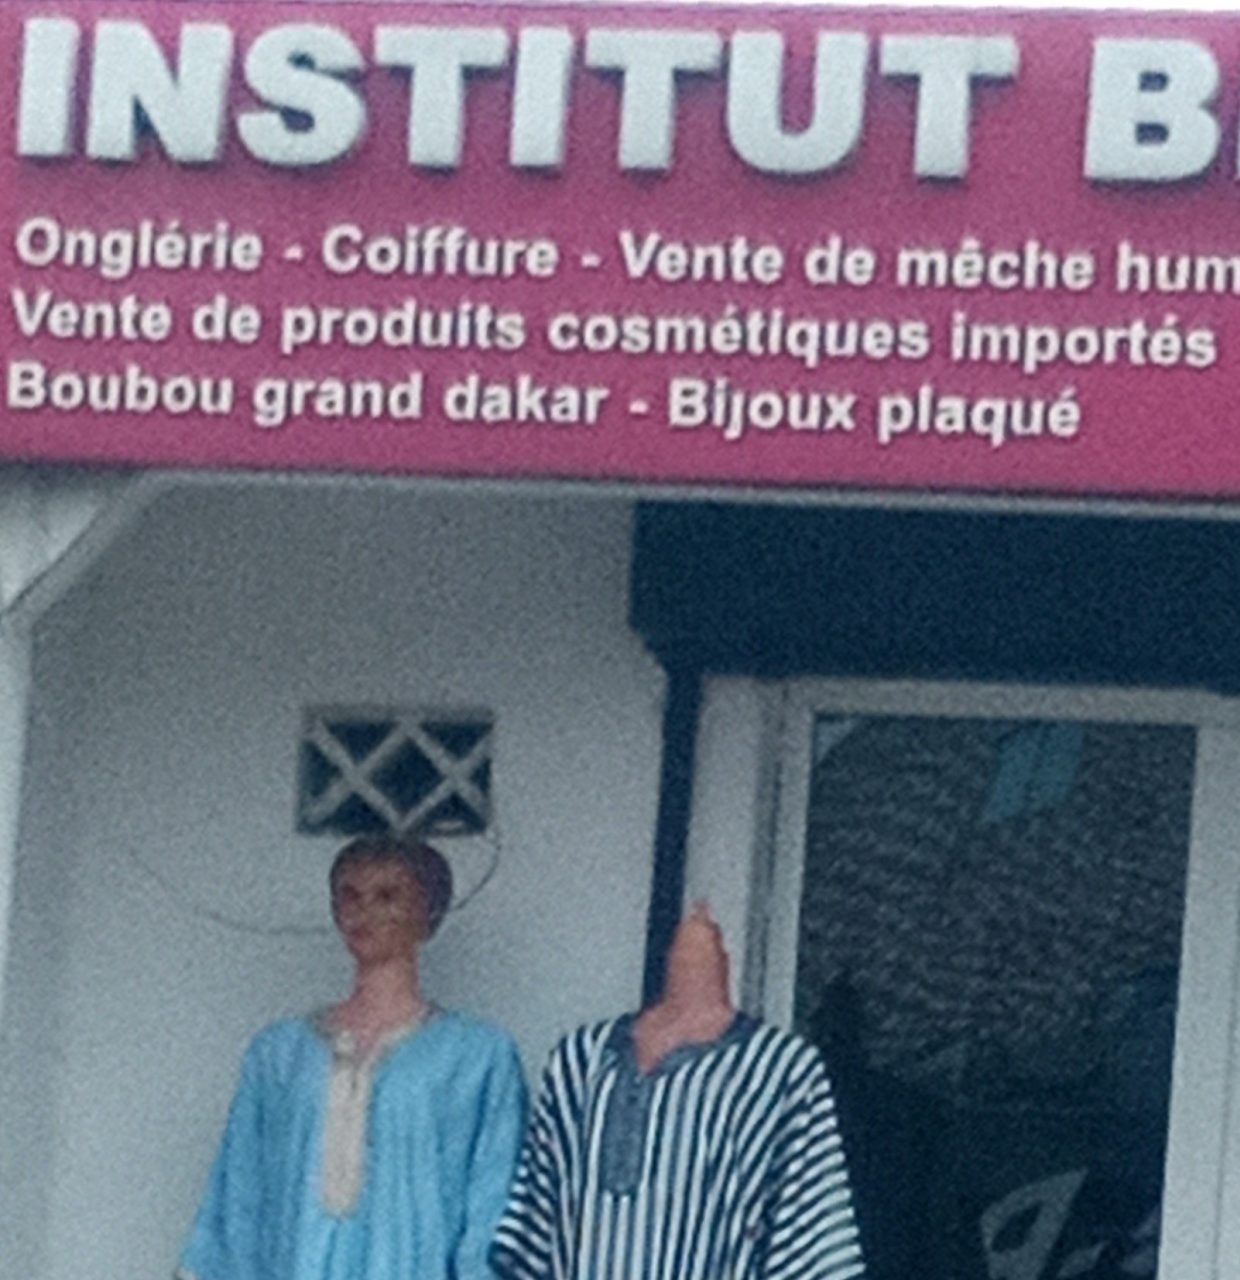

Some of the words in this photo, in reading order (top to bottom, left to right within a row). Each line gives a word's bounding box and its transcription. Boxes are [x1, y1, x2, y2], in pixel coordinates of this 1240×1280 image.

[17, 12, 1020, 175] INSTITUT
[16, 217, 262, 278] Onglérie
[323, 225, 559, 276] Coiffure
[620, 231, 784, 283] Vente
[805, 236, 875, 284] de
[13, 289, 171, 340] Vente
[192, 295, 260, 342] de
[282, 299, 525, 353] produits
[548, 305, 930, 367] cosmétiques
[952, 312, 1216, 372] importés
[8, 361, 232, 412] Boubou
[254, 372, 422, 426] grand
[444, 374, 608, 422] dakar
[669, 378, 855, 439] Bijoux
[879, 385, 1080, 445] plaqué
